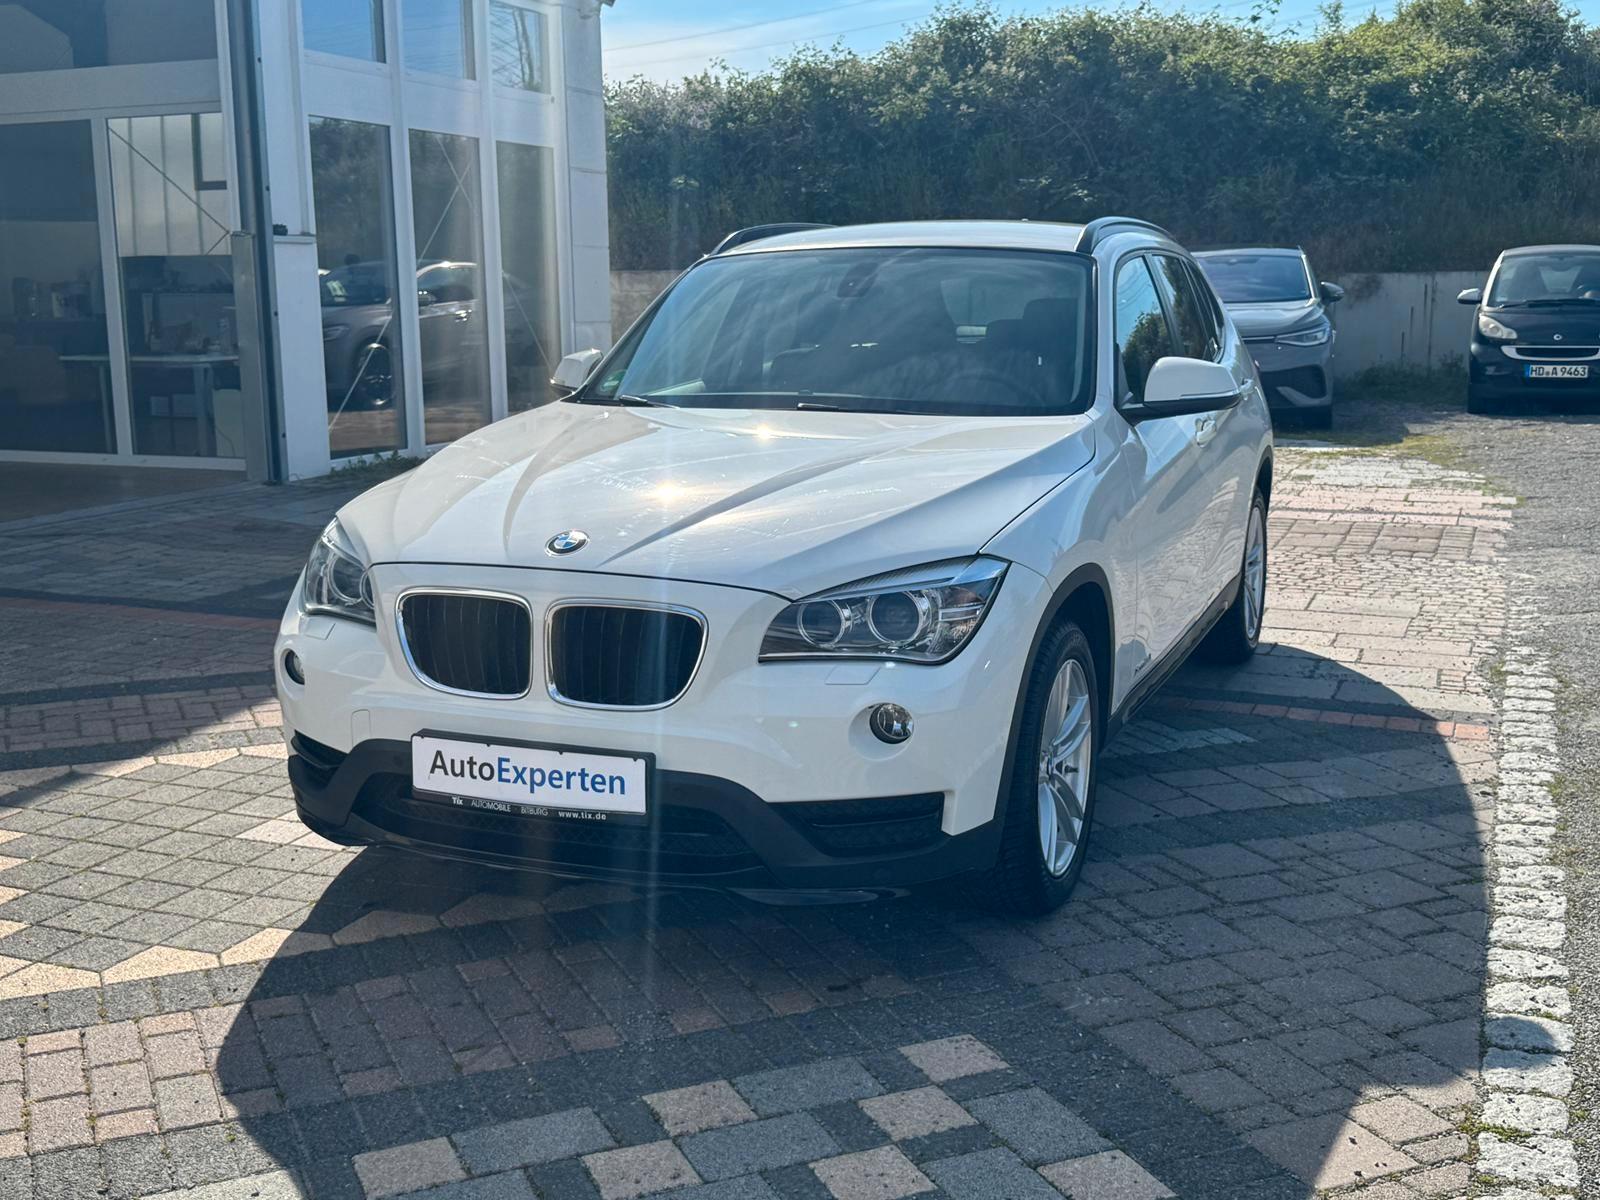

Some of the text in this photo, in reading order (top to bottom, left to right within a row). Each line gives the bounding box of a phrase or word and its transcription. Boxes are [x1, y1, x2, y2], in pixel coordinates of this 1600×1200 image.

[1560, 366, 1586, 377] 9463
[429, 750, 626, 795] AutoExperten
[471, 799, 511, 813] AUTOMOBILE
[558, 810, 607, 821] www.tix.de
